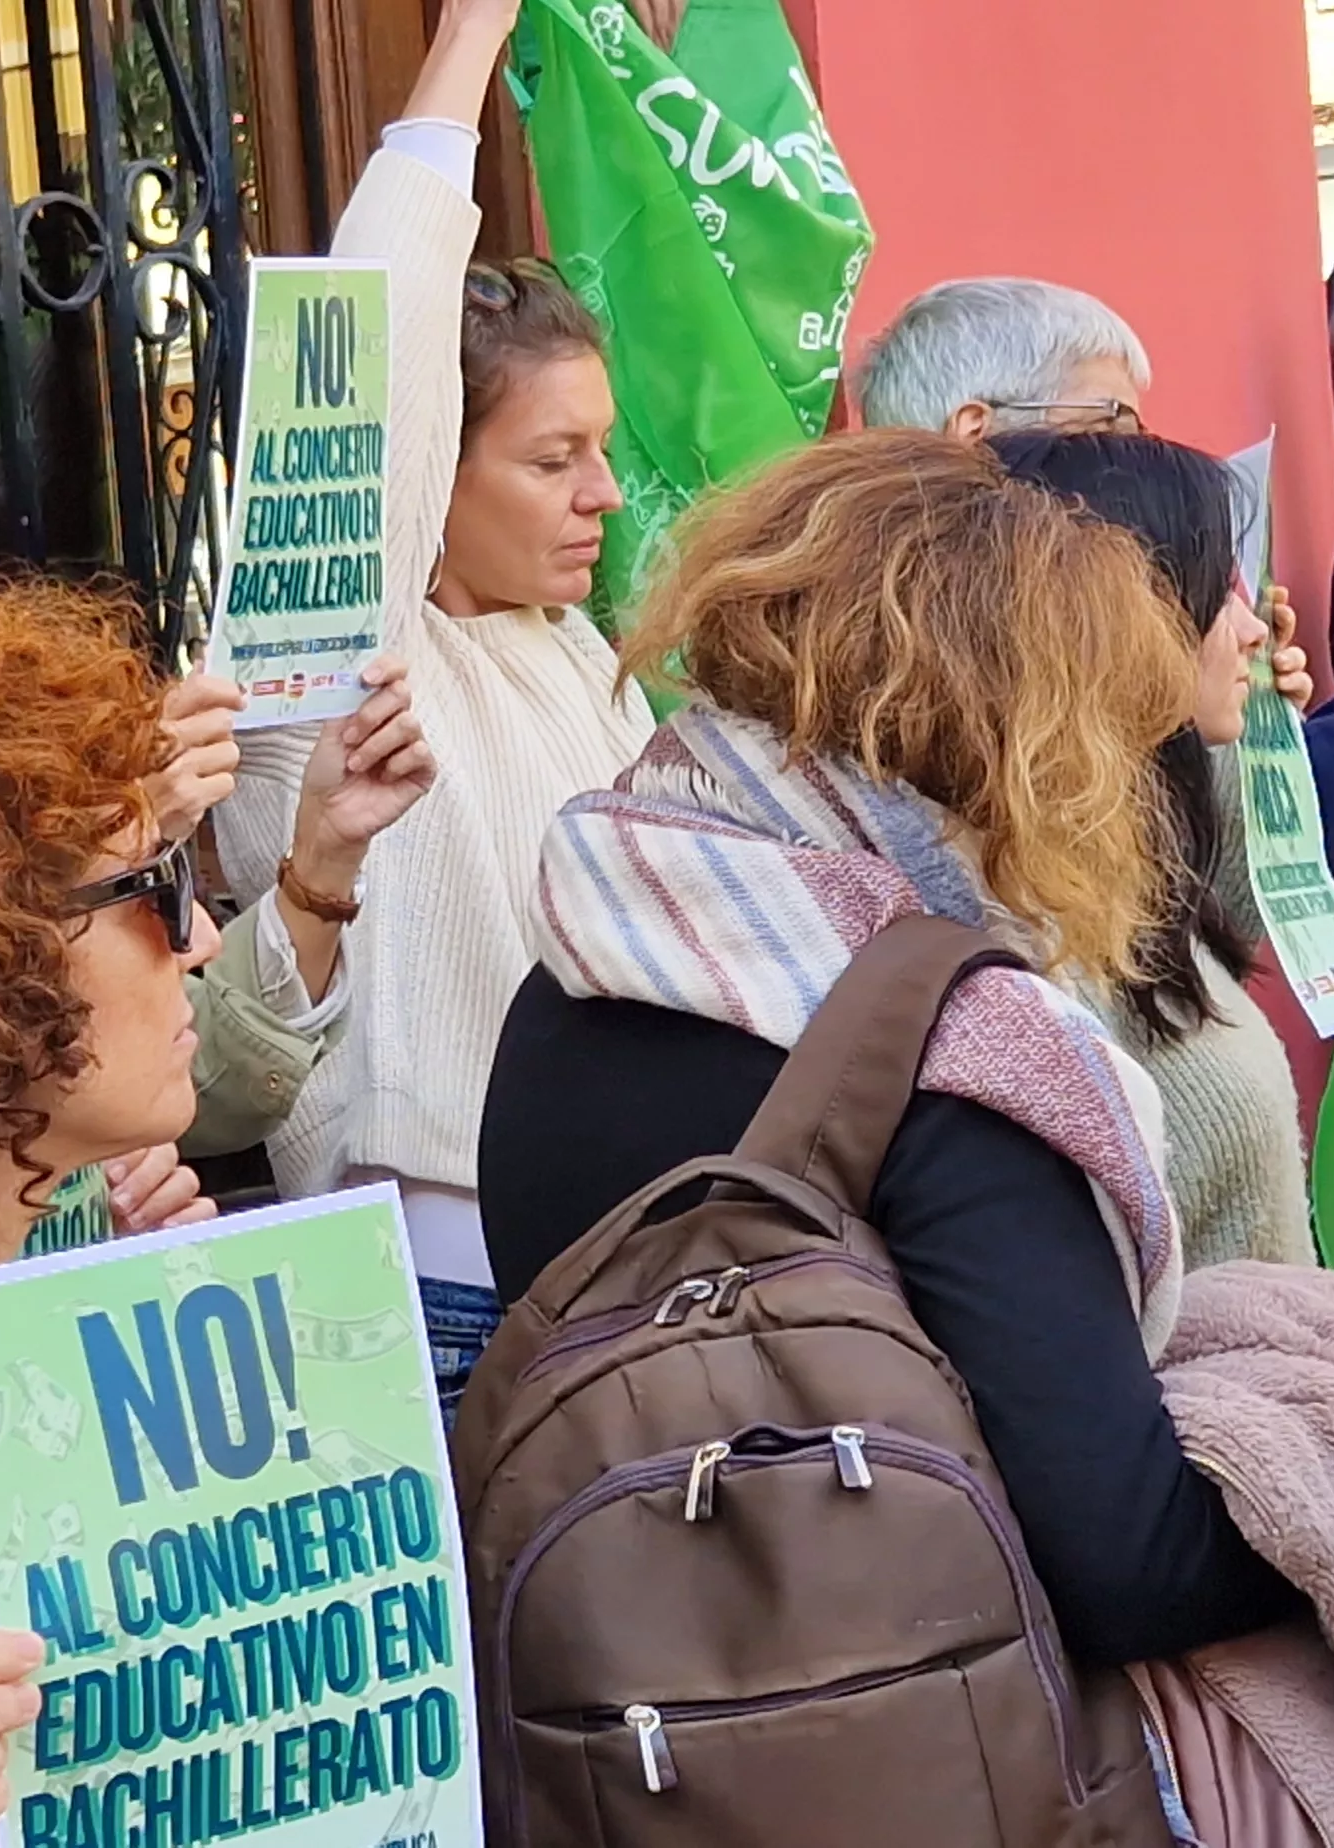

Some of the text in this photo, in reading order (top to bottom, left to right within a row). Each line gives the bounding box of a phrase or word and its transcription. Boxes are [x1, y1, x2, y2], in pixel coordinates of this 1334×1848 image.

[295, 296, 356, 409] NO!
[243, 486, 383, 550] EDUCATIVO EN
[250, 422, 383, 484] AL CONCIERTO
[226, 551, 383, 615] BACHILLERATO
[77, 1272, 311, 1506] NO!
[25, 1465, 439, 1663] AL CONCIERTO
[35, 1574, 453, 1774] EDUCATIVO EN
[19, 1686, 460, 1848] BACHILLERATO
